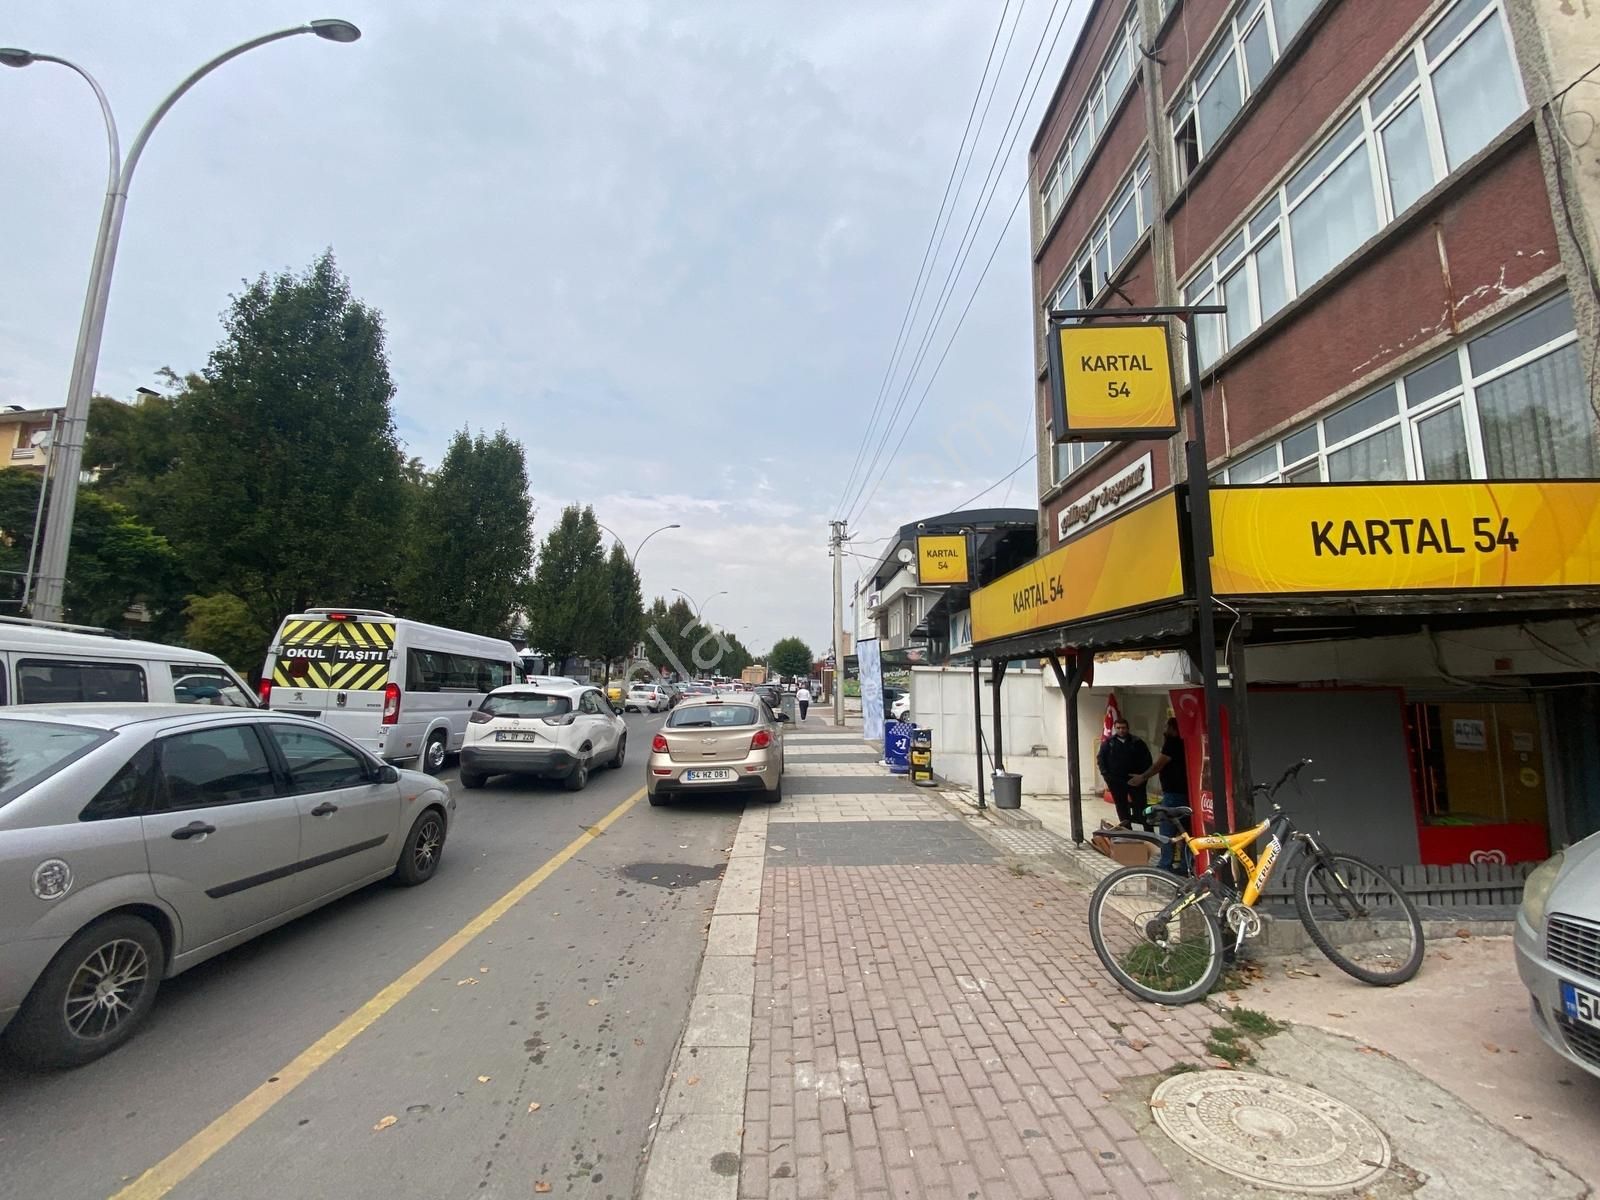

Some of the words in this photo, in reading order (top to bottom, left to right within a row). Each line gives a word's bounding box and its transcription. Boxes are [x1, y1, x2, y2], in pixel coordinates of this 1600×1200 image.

[1081, 355, 1153, 372] KARTAL
[1107, 381, 1131, 398] 54
[1311, 518, 1466, 556] KARTAL
[1472, 517, 1519, 553] 54
[926, 549, 959, 558] KARTAL
[937, 561, 949, 570] 54
[1013, 583, 1048, 615] KARTAL
[1049, 575, 1064, 602] 54
[286, 648, 326, 659] OKUL
[338, 650, 384, 661] TAŞITI
[691, 771, 701, 779] 54
[714, 770, 728, 778] 081
